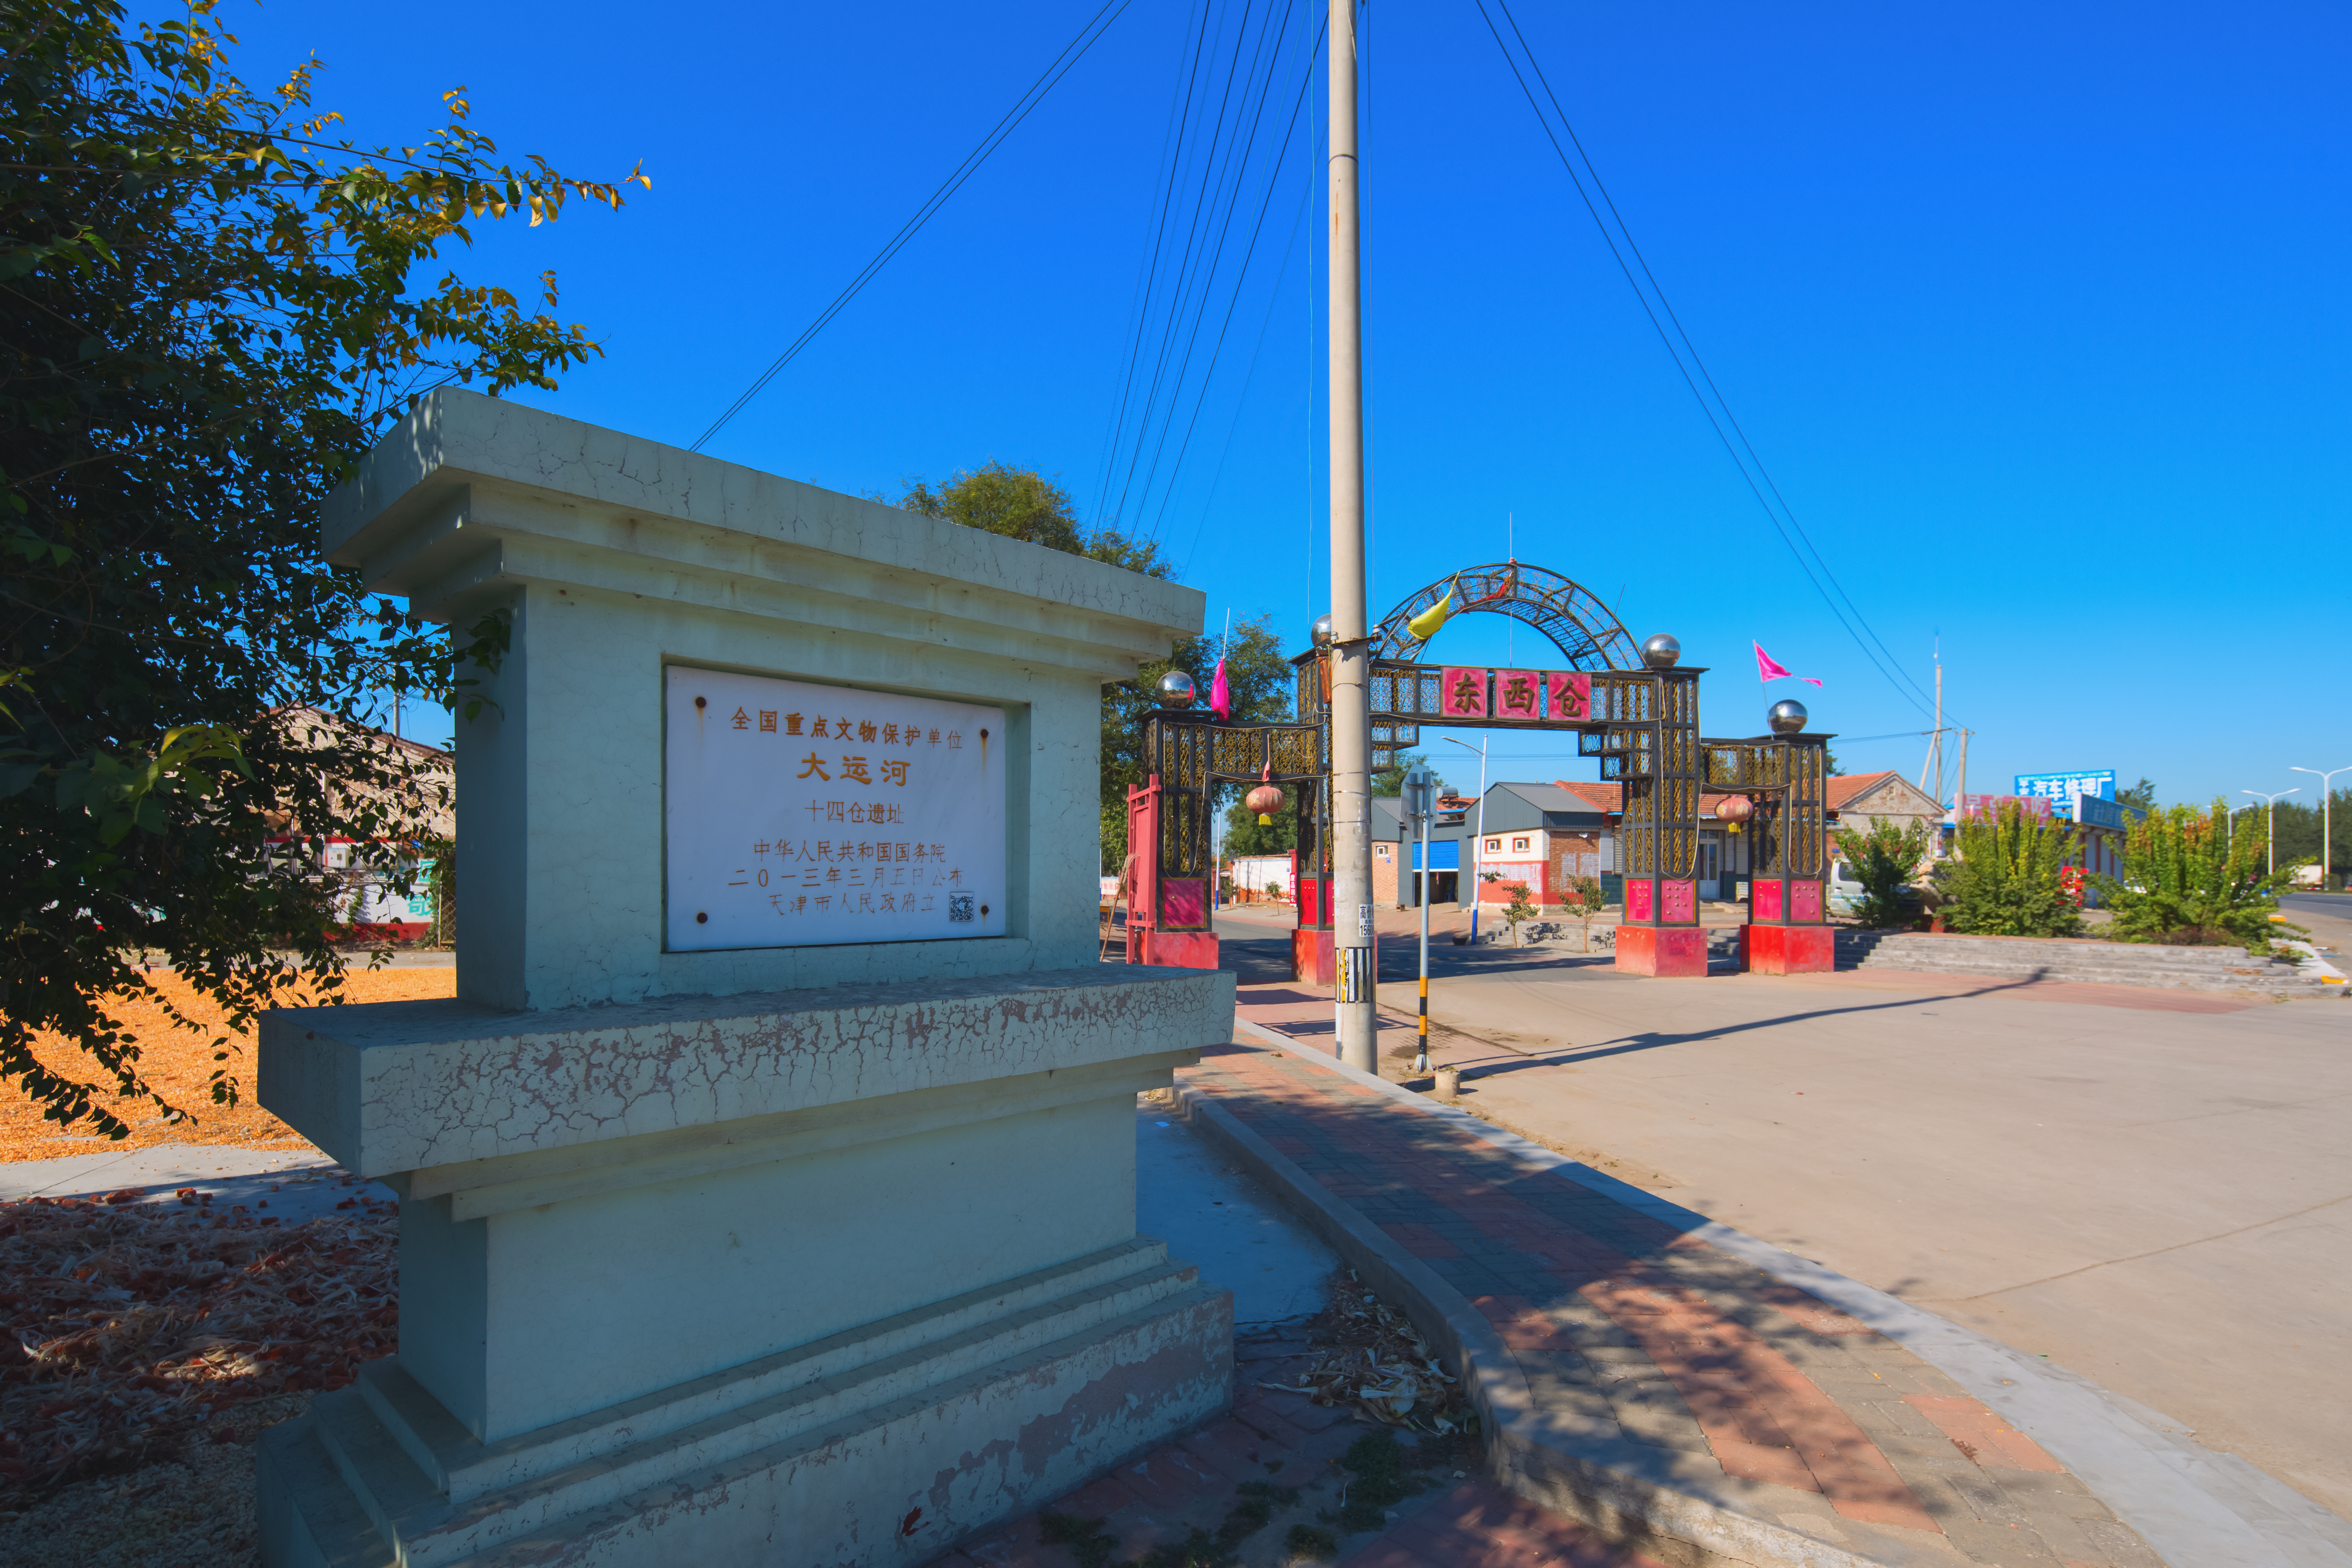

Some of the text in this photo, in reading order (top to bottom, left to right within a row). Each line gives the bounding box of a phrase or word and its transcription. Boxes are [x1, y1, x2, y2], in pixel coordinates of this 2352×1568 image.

[1453, 672, 1588, 717] 东西仓
[730, 706, 963, 750] 全国重点文物保护单位
[796, 752, 911, 786] 大运河
[2033, 777, 2112, 801] 汽车修理厂
[804, 800, 904, 824] 十四仓遗址
[754, 838, 946, 863] 中华人民共和国国务院
[768, 892, 936, 916] 天津市人民政府立
